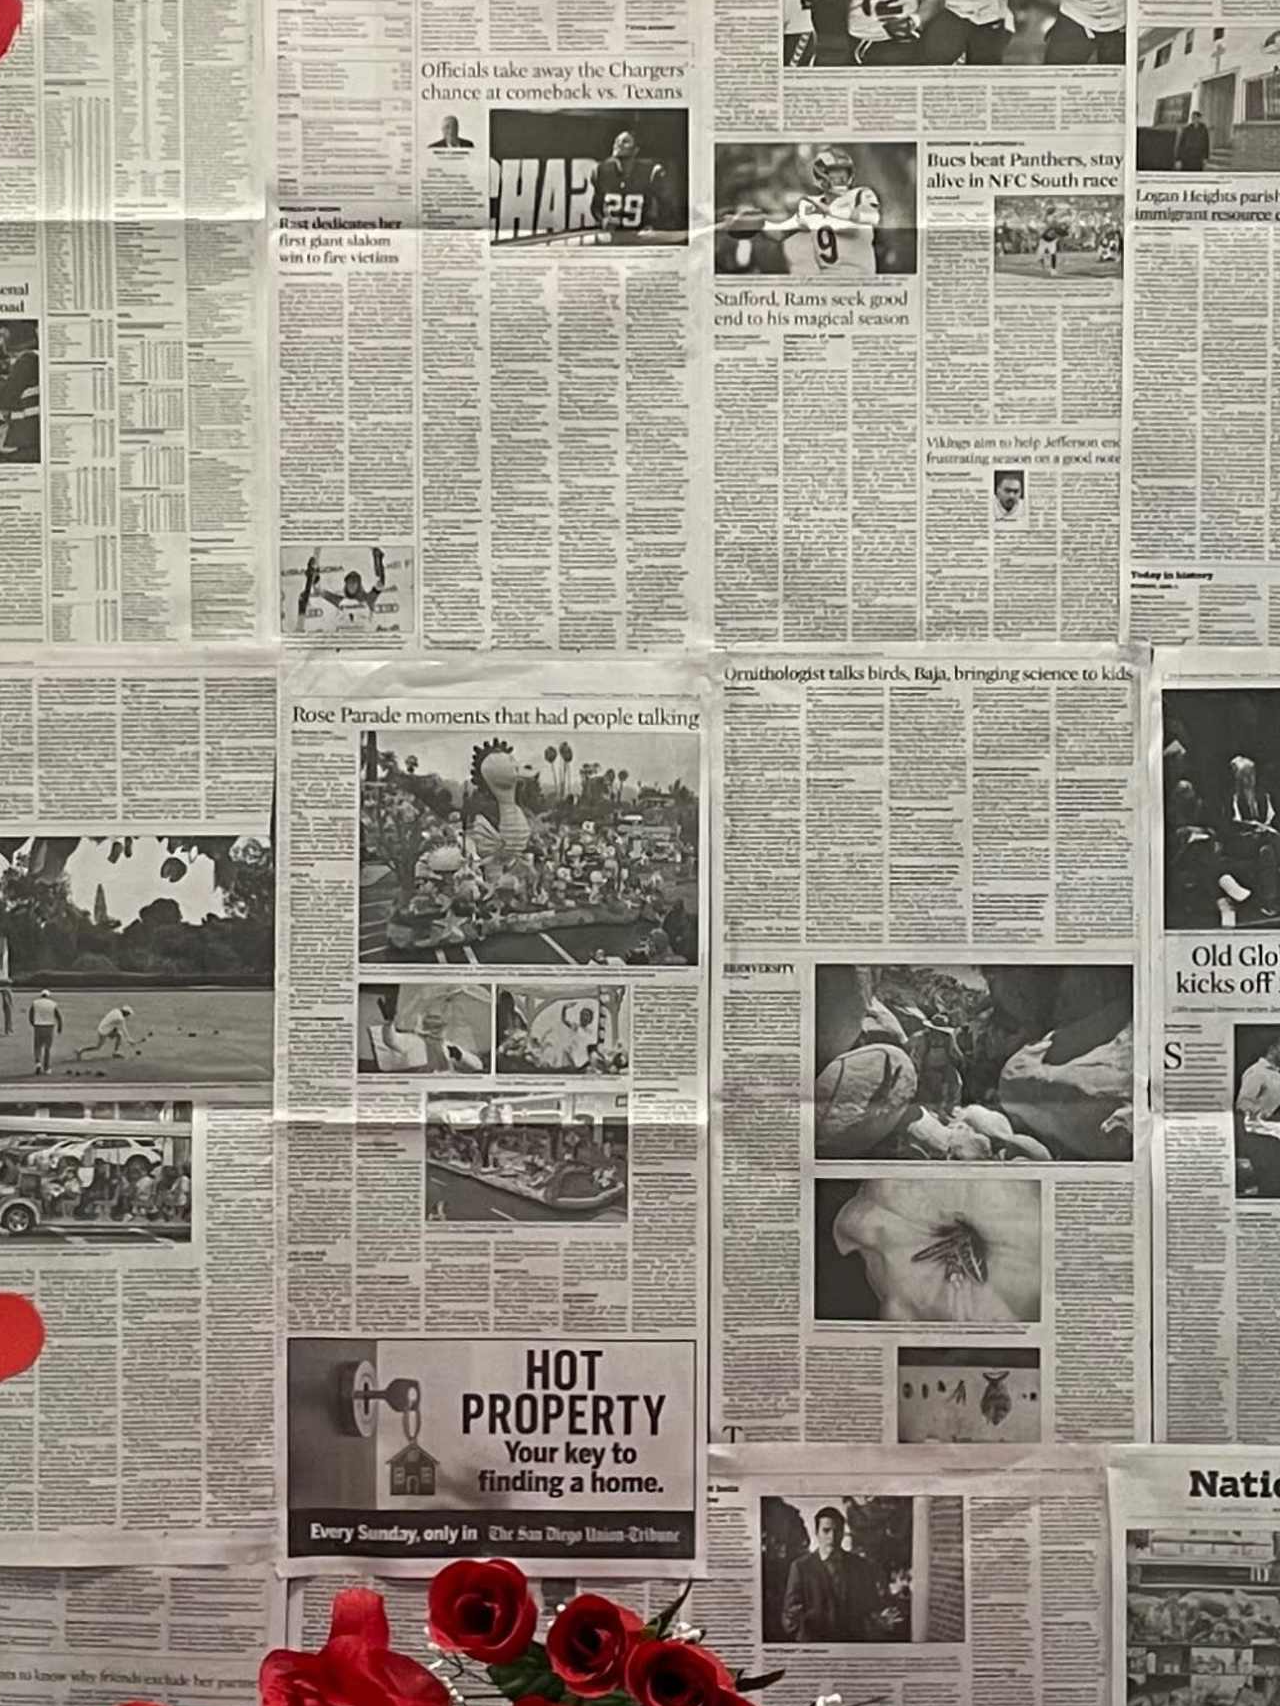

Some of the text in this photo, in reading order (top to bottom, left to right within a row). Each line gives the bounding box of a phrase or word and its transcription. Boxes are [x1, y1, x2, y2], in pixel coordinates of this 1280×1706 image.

[421, 61, 489, 78] Officials
[493, 61, 528, 78] take
[532, 67, 574, 82] away
[578, 61, 605, 79] the
[421, 83, 682, 101] chance at comeback vs. Texans
[928, 151, 1125, 171] Bucs beat Panthers, stay
[927, 172, 1118, 188] alive in NFC South race
[604, 194, 644, 227] 29
[817, 226, 838, 264] 9
[723, 663, 1136, 684] Ornithologist talks birds, Baja, bringing science to kids
[292, 705, 700, 729] Rose Parade moments that had people talking
[1192, 944, 1232, 967] Old
[1177, 971, 1235, 994] kicks
[1240, 971, 1276, 994] off
[527, 1349, 603, 1391] HOT
[463, 1393, 666, 1436] PROPERTY
[504, 1440, 637, 1467] Your key to
[478, 1469, 663, 1497] finding a home.
[311, 1523, 477, 1545] Every Sunday, only in
